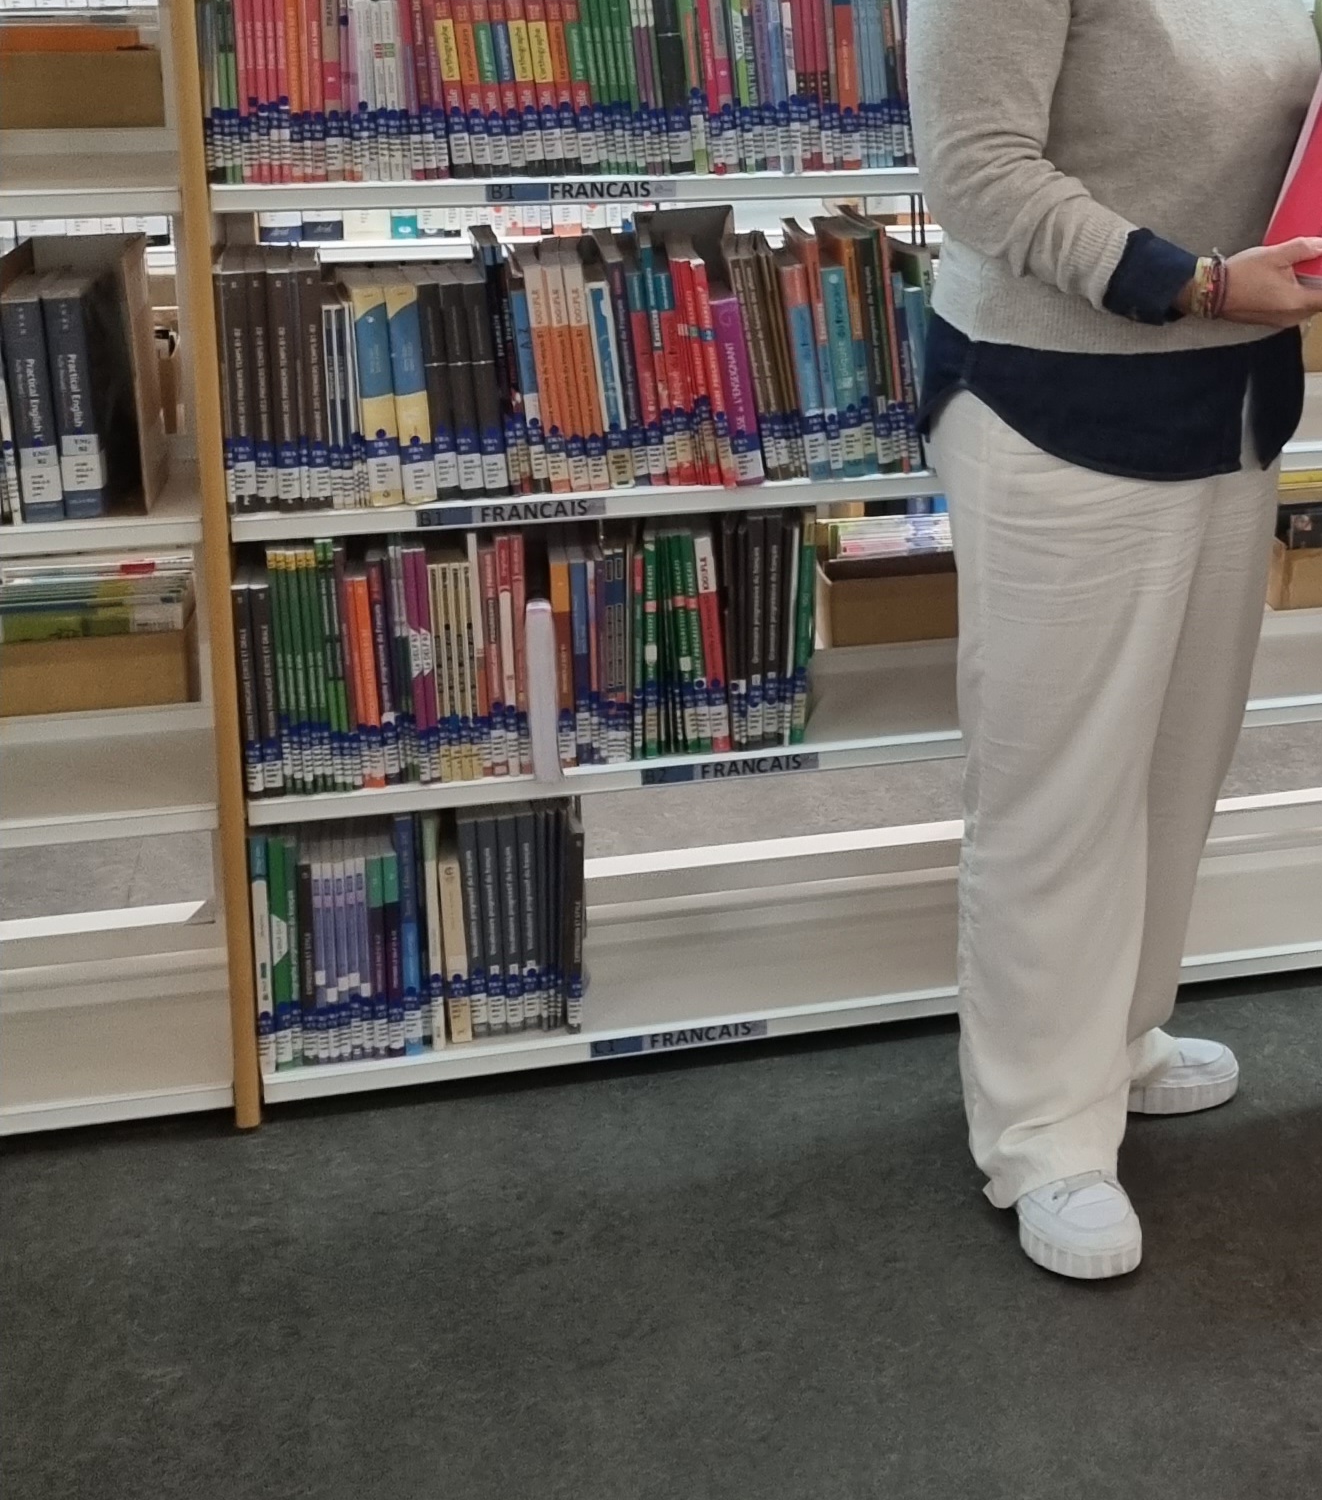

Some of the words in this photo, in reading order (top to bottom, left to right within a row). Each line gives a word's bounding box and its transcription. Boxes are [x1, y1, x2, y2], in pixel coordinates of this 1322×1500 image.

[491, 185, 516, 200] B1
[26, 358, 40, 397] Practical
[66, 354, 80, 396] Practical
[70, 399, 84, 428] English
[420, 511, 444, 526] B1
